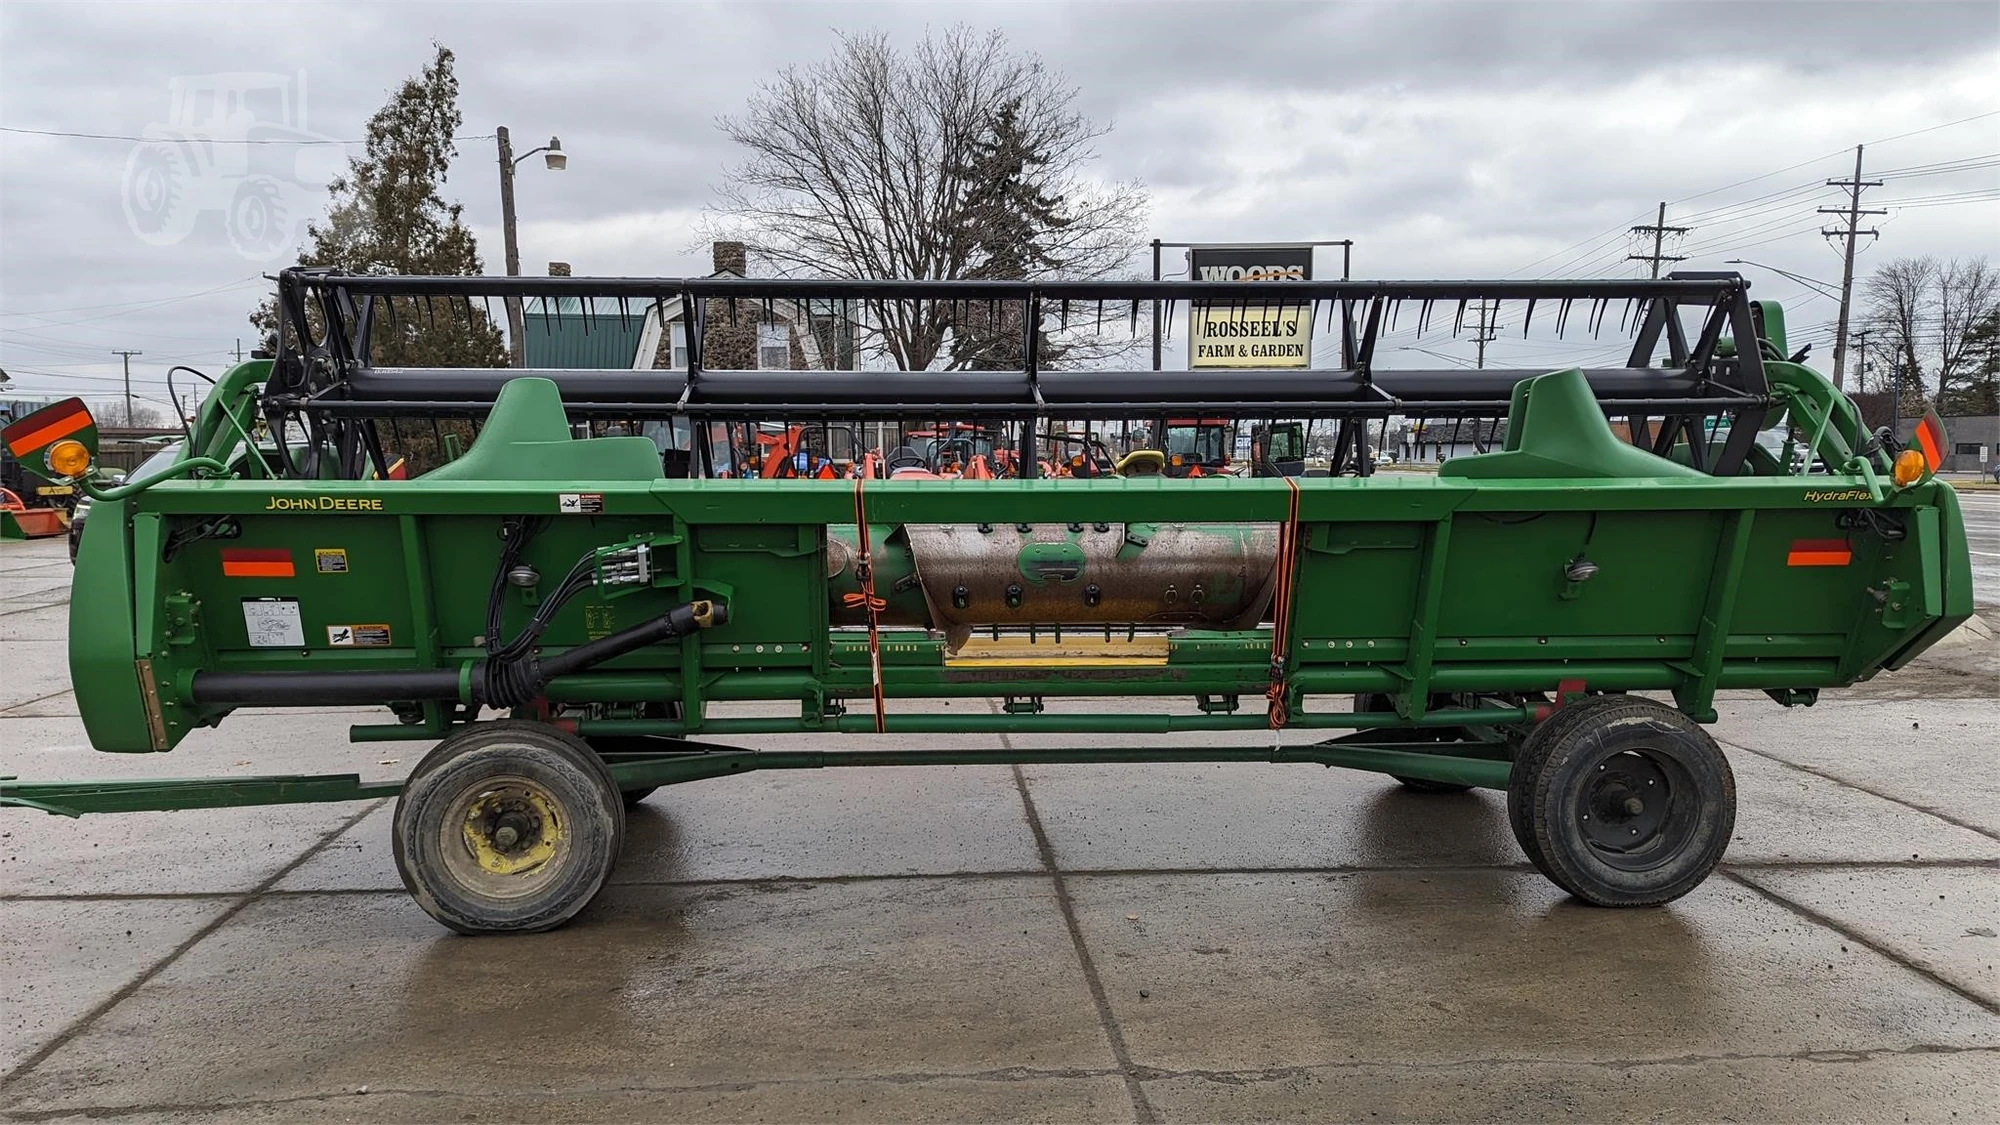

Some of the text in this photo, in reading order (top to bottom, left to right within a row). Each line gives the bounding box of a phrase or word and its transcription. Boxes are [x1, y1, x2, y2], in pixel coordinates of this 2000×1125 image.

[1200, 265, 1304, 282] WOODS
[1207, 320, 1297, 337] ROSSEEL'S
[1198, 344, 1304, 358] FARM & GARDEN
[265, 496, 384, 510] JOHN DEERE
[1804, 490, 1873, 503] HydraFlex
